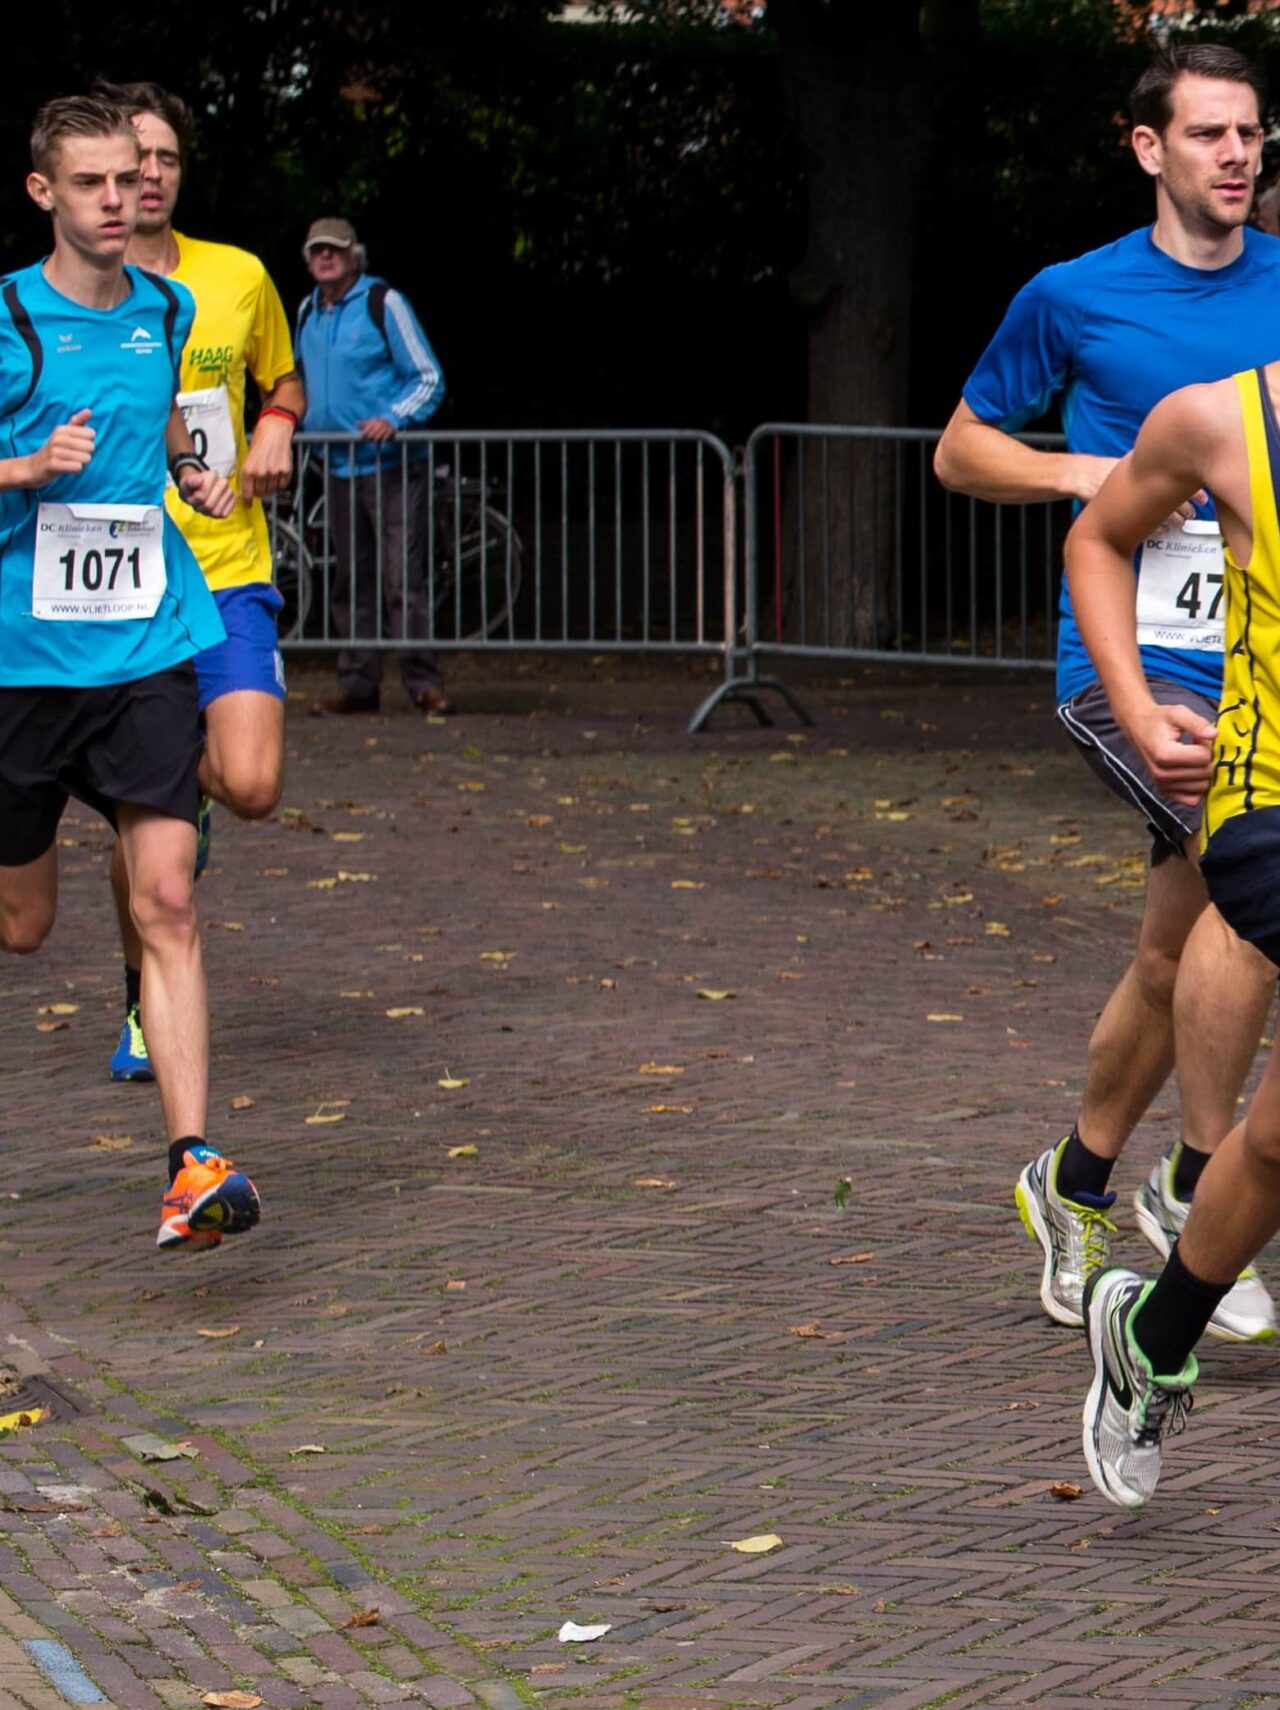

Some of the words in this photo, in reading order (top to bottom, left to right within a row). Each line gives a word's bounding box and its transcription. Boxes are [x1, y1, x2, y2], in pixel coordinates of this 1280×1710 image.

[189, 345, 233, 366] HAAG
[40, 523, 57, 532] DC
[1147, 540, 1163, 550] DC
[59, 547, 142, 591] 1071
[1176, 572, 1225, 620] 47
